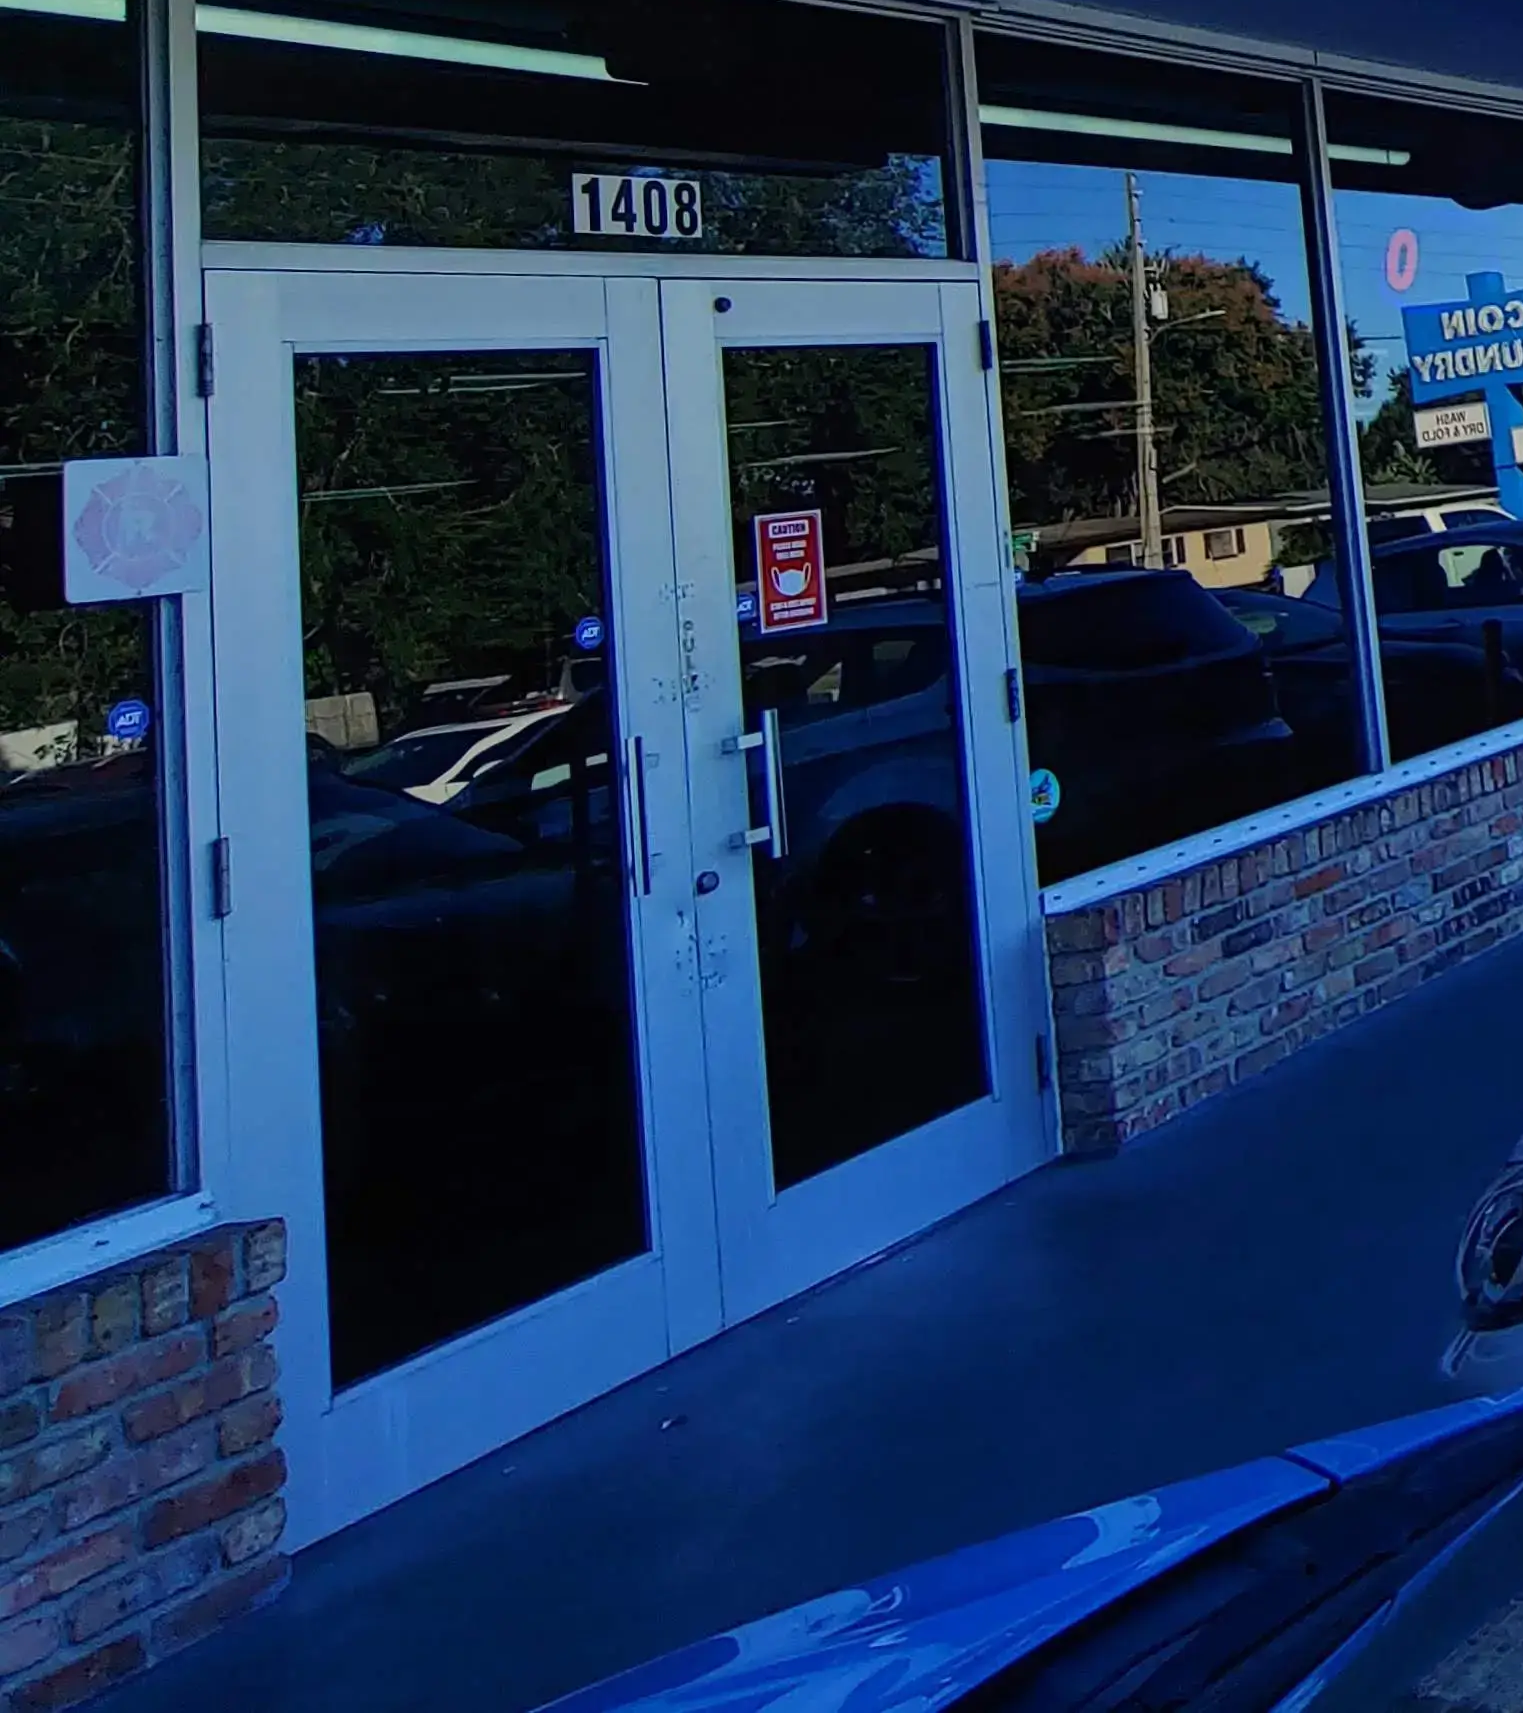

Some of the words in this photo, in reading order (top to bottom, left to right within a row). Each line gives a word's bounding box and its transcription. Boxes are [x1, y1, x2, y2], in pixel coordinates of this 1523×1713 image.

[581, 178, 698, 235] 1408
[582, 626, 600, 641] ADT
[115, 710, 143, 727] ADT
